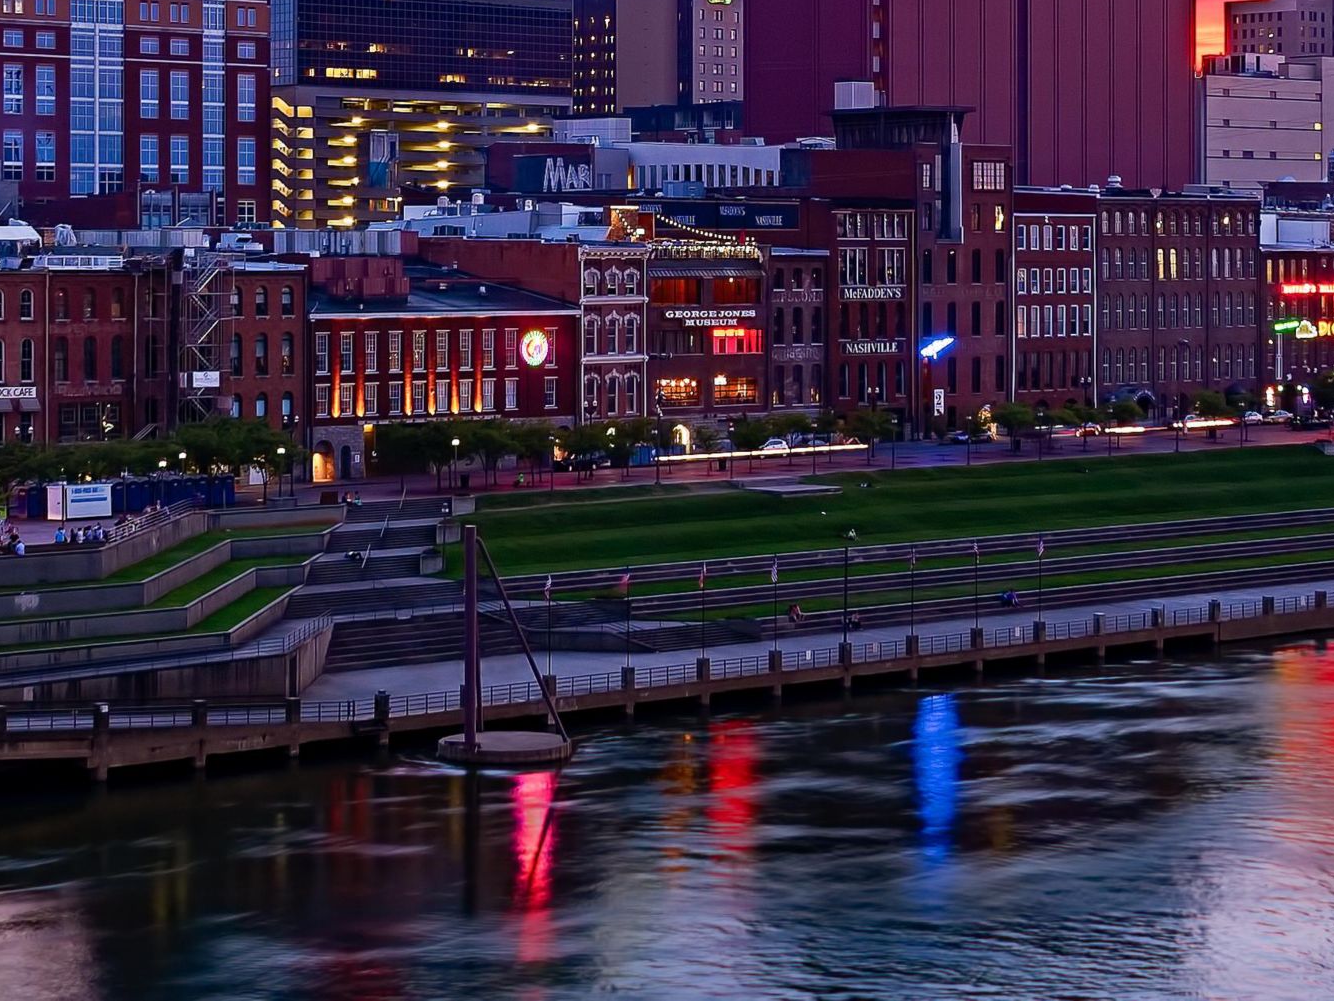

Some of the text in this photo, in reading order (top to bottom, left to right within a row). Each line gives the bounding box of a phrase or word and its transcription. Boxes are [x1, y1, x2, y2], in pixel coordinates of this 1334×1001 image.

[844, 288, 902, 299] McFADDEN'S
[665, 309, 756, 318] GEORGE JONES
[685, 318, 738, 327] MUSEUM
[845, 342, 898, 354] NASHVILLE
[13, 387, 34, 397] CAFE
